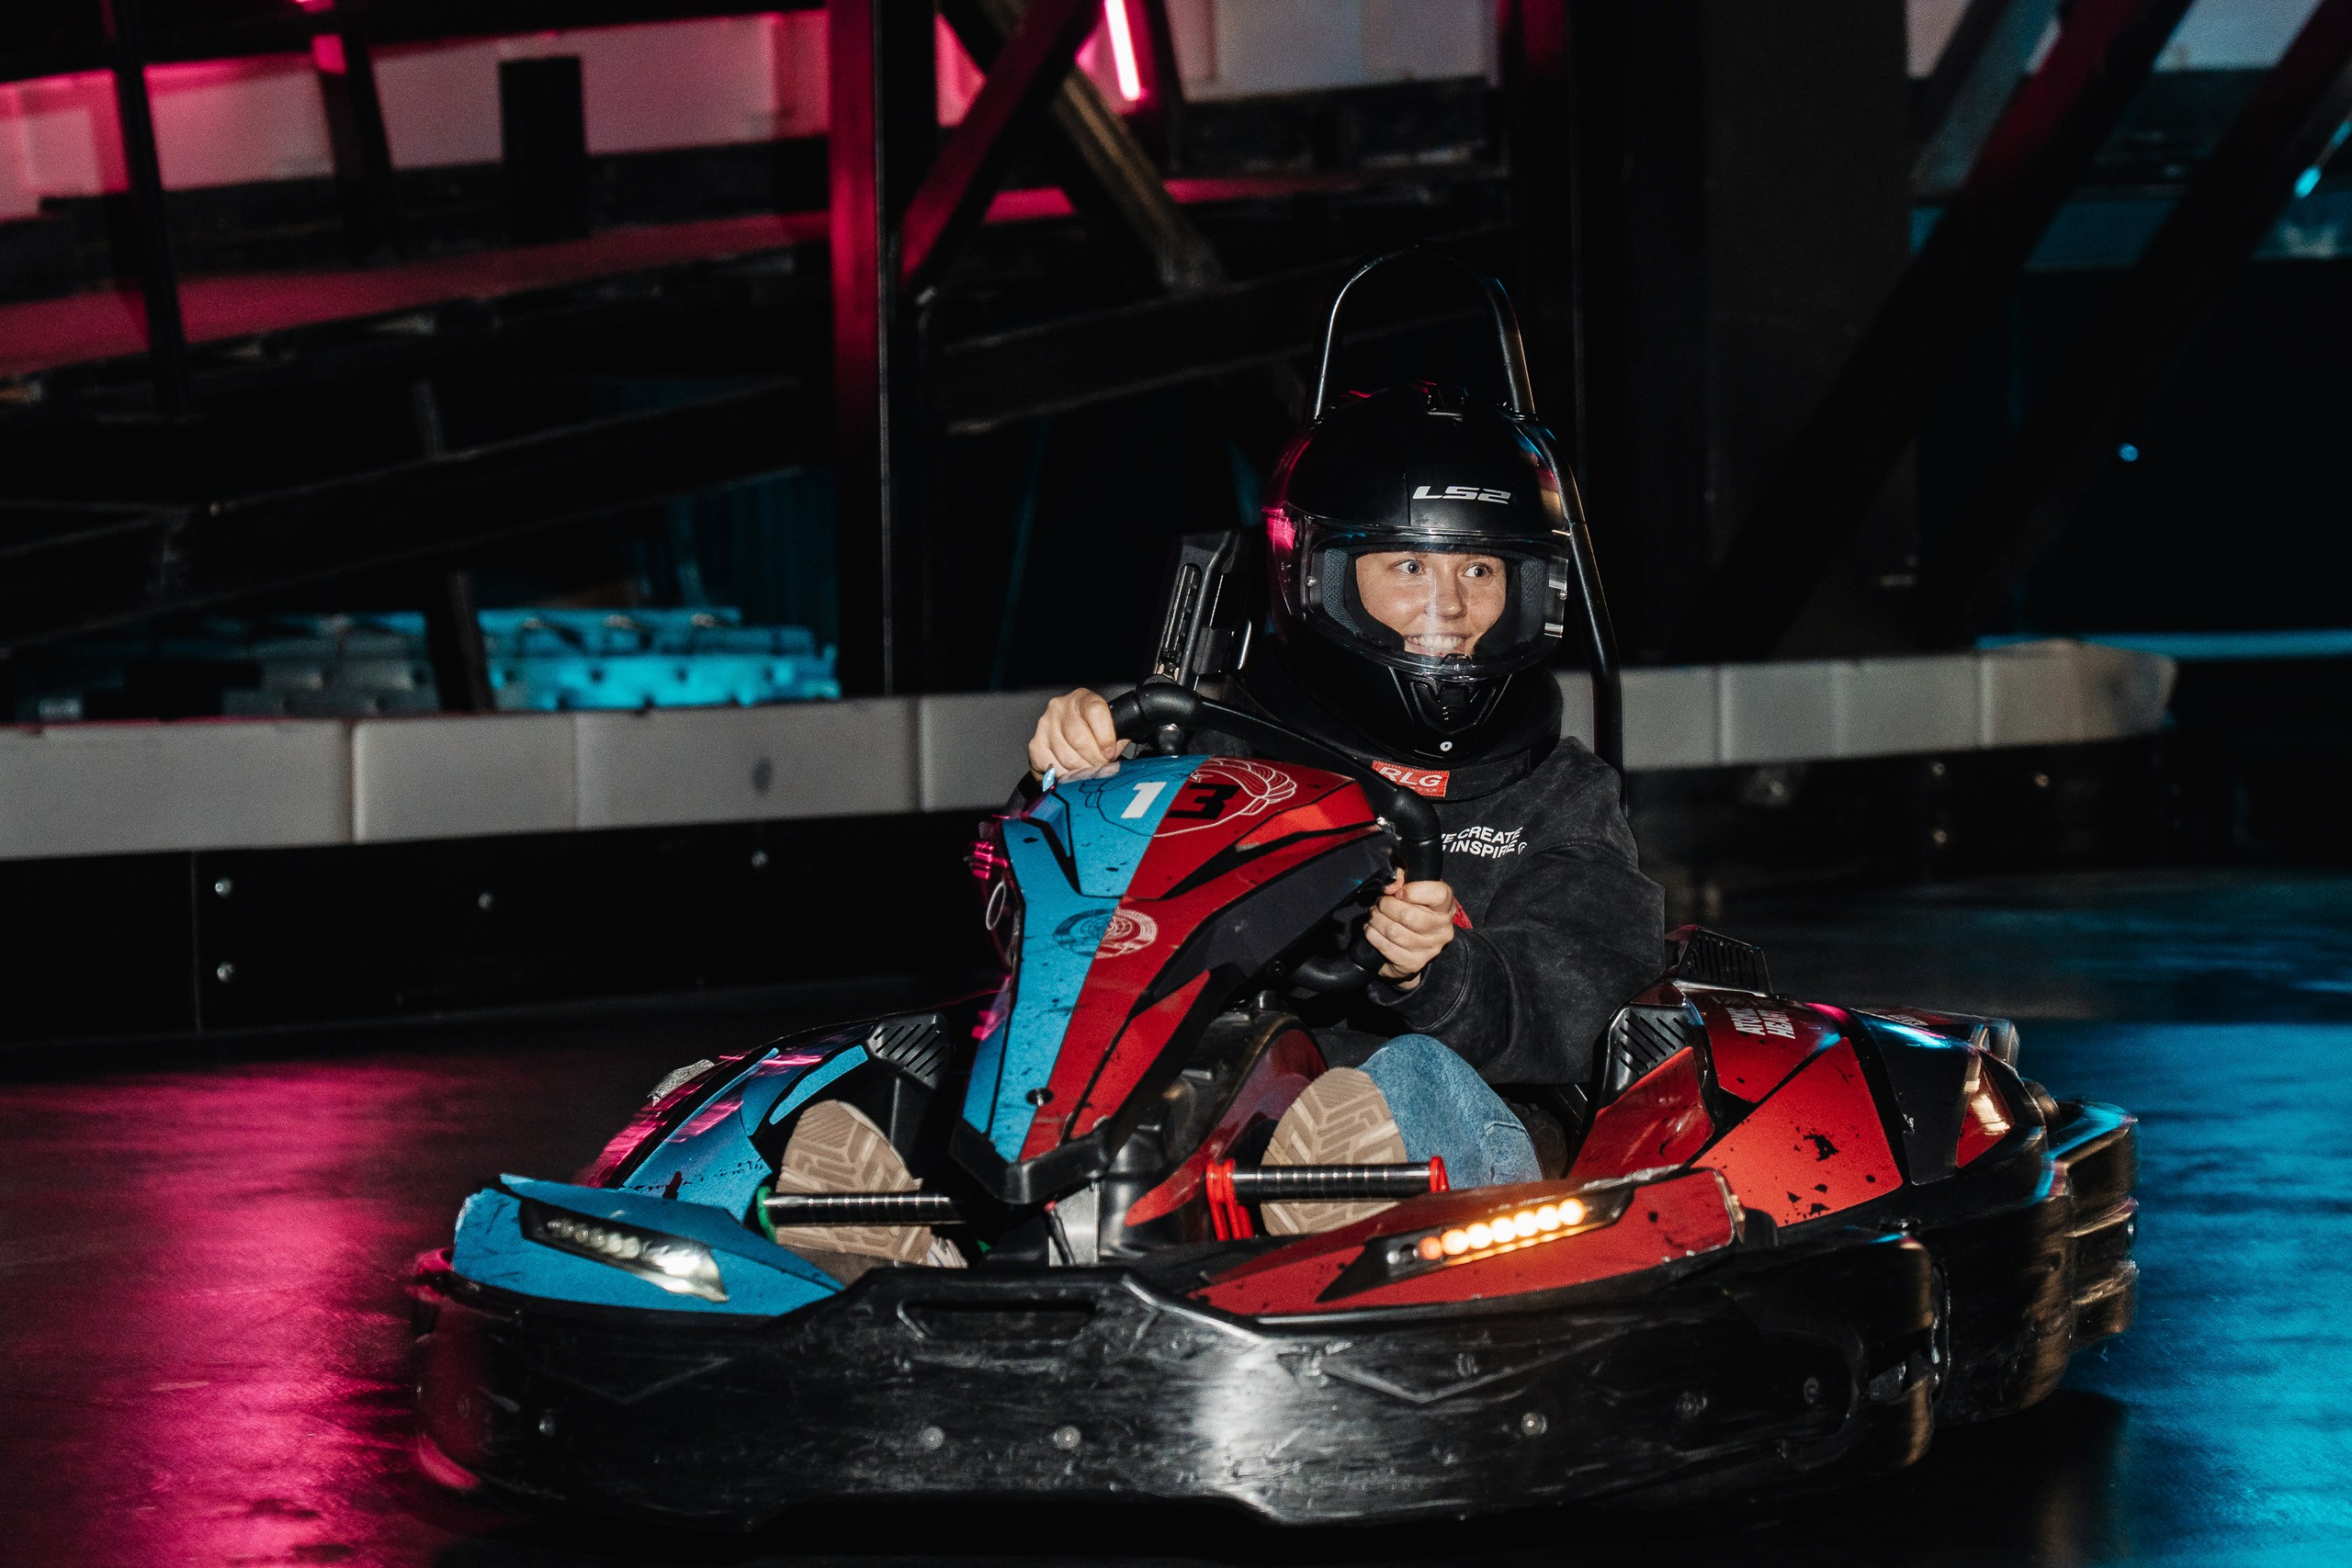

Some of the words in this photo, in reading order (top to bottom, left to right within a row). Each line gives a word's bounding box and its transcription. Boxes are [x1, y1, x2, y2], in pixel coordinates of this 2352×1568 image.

[1412, 486, 1511, 504] LS2
[1378, 766, 1443, 787] RLG
[1121, 781, 1240, 820] 13
[1457, 826, 1523, 844] CREATE
[1450, 840, 1518, 859] INSPIRE
